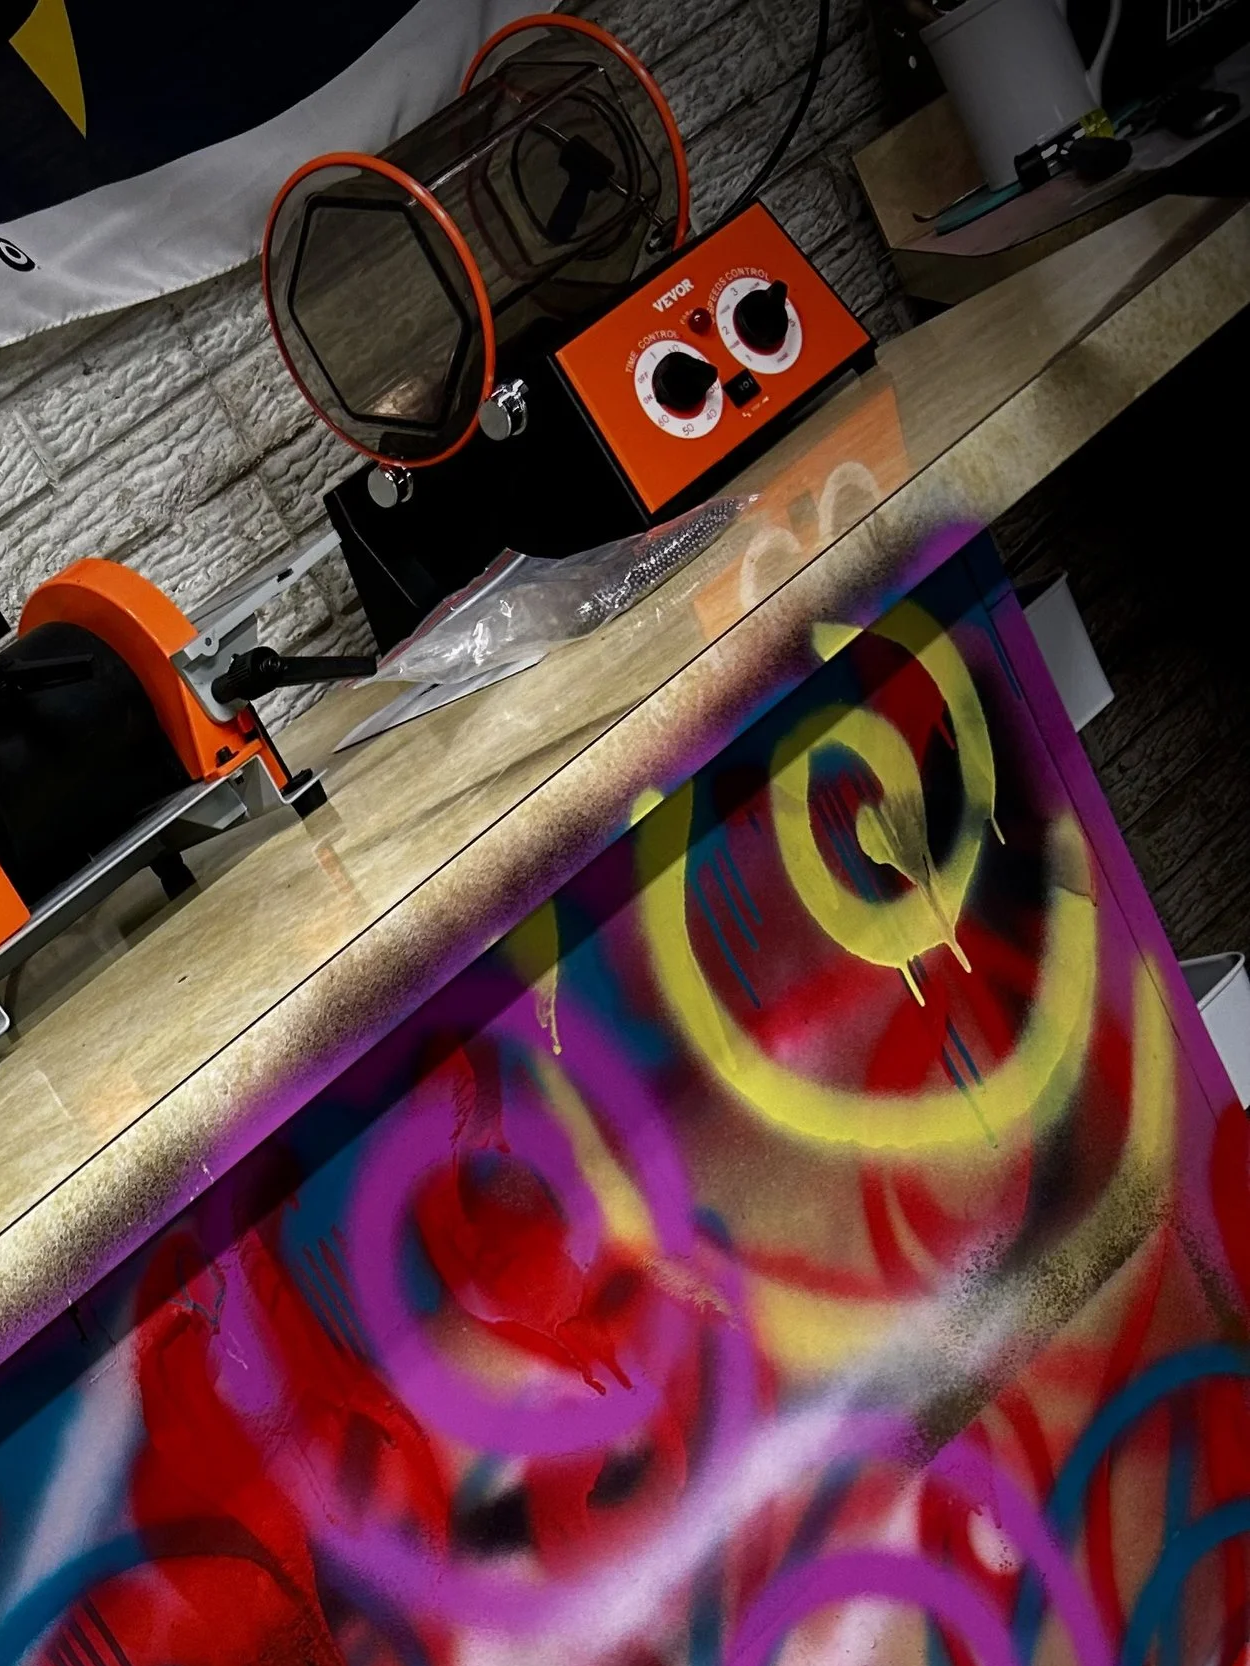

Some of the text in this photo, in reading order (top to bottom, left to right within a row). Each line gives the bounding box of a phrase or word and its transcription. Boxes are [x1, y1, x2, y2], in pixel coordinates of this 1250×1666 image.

[724, 267, 769, 281] CONTROL
[652, 278, 695, 313] VEVOR
[721, 325, 730, 336] 2
[624, 329, 680, 374] TIME CONTROL
[705, 408, 718, 421] 40
[682, 423, 695, 437] 50
